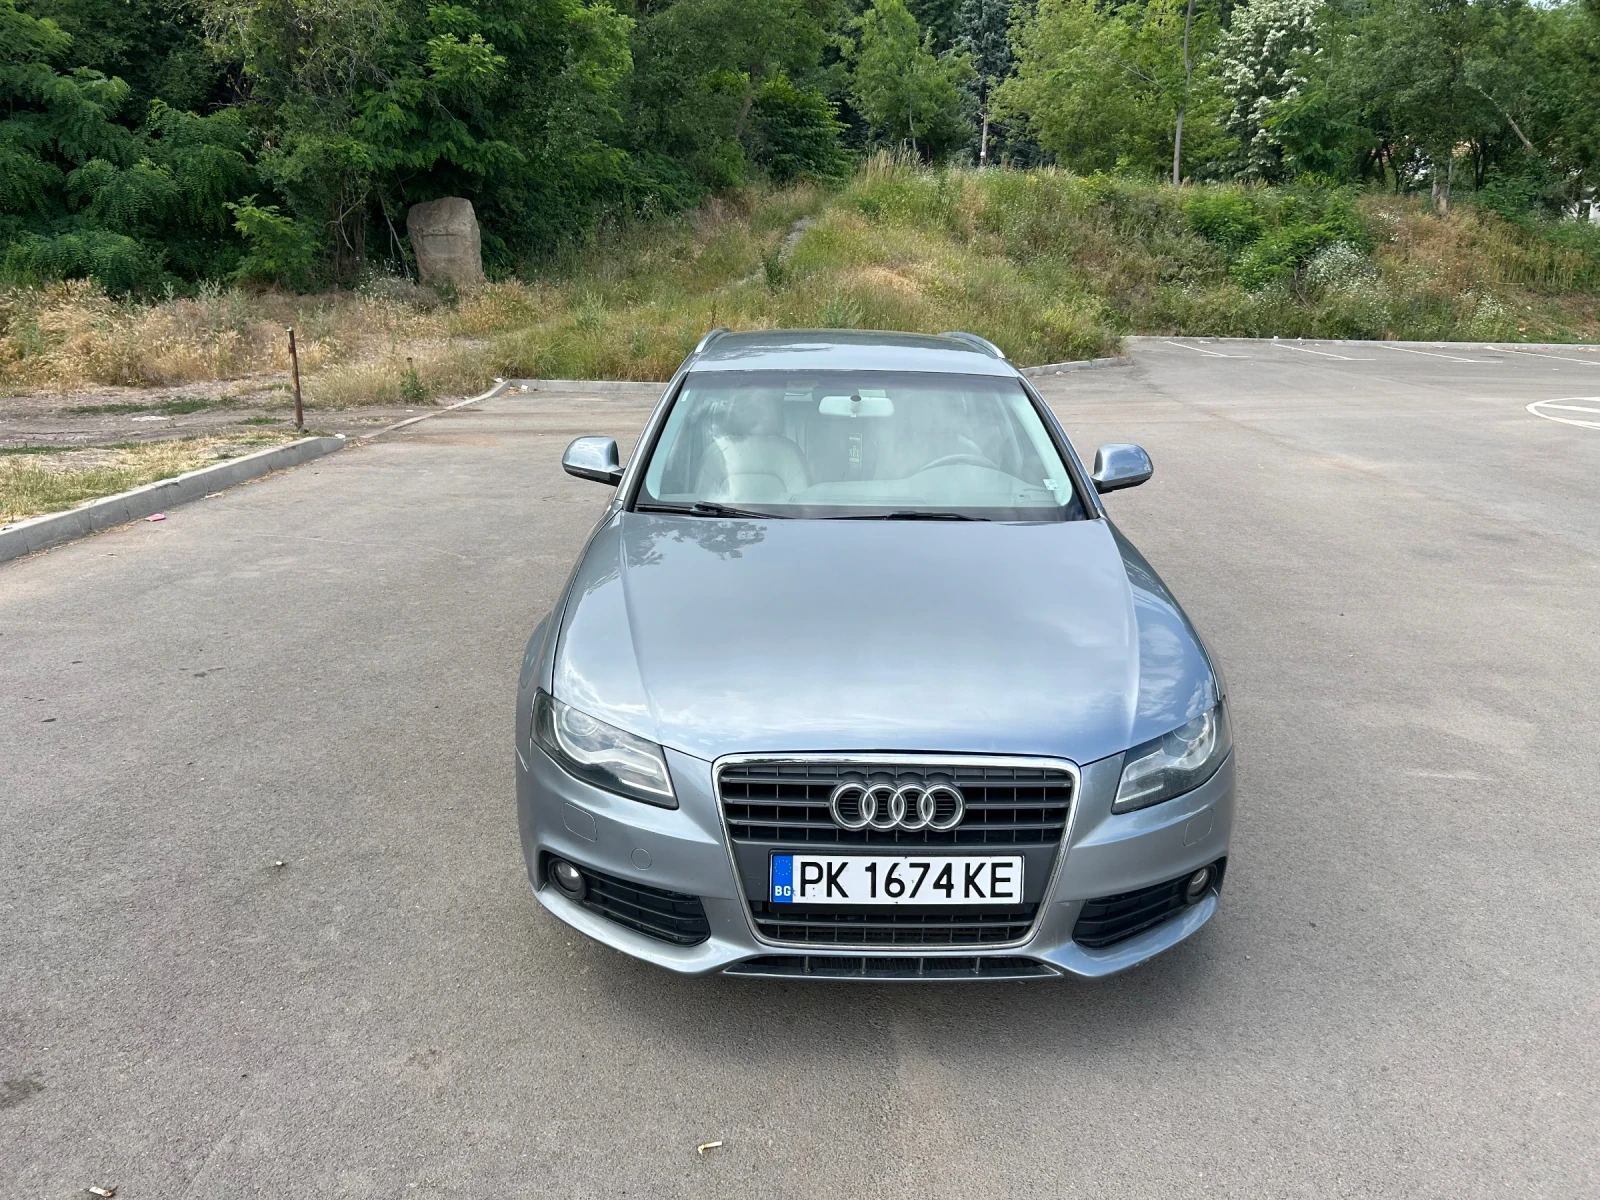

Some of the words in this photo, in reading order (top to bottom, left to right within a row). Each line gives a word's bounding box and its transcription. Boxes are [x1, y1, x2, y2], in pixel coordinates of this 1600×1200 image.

[774, 885, 791, 897] BG
[800, 861, 849, 898] PK
[864, 862, 954, 898] 1674
[963, 862, 1013, 898] KE
